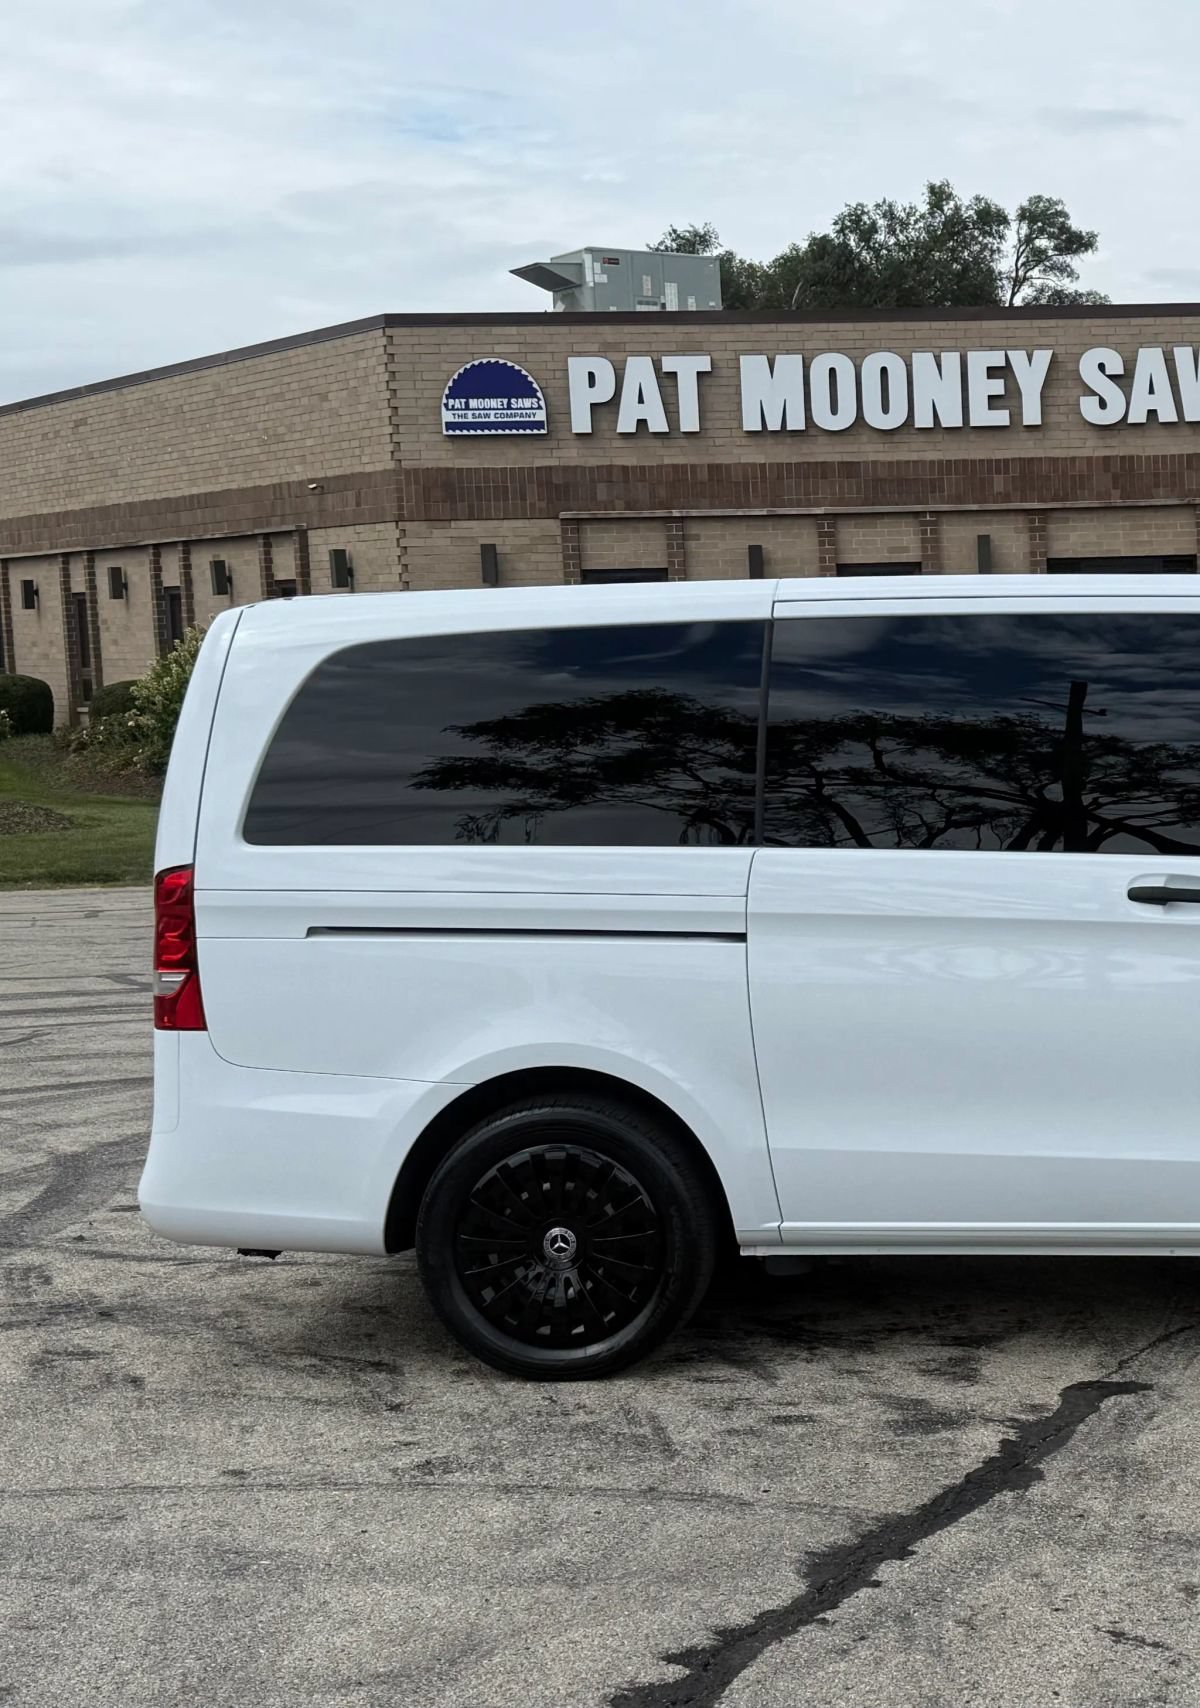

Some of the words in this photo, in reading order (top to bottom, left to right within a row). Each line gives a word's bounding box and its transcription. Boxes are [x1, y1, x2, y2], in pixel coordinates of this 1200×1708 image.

[567, 355, 712, 434] PAT
[739, 349, 1054, 432] MOONEY
[448, 398, 467, 409] PAT
[469, 398, 508, 409] MOONEY
[510, 398, 539, 409] SAWS
[452, 412, 469, 420] THE
[471, 412, 491, 420] SAW
[493, 411, 537, 420] COMPANY
